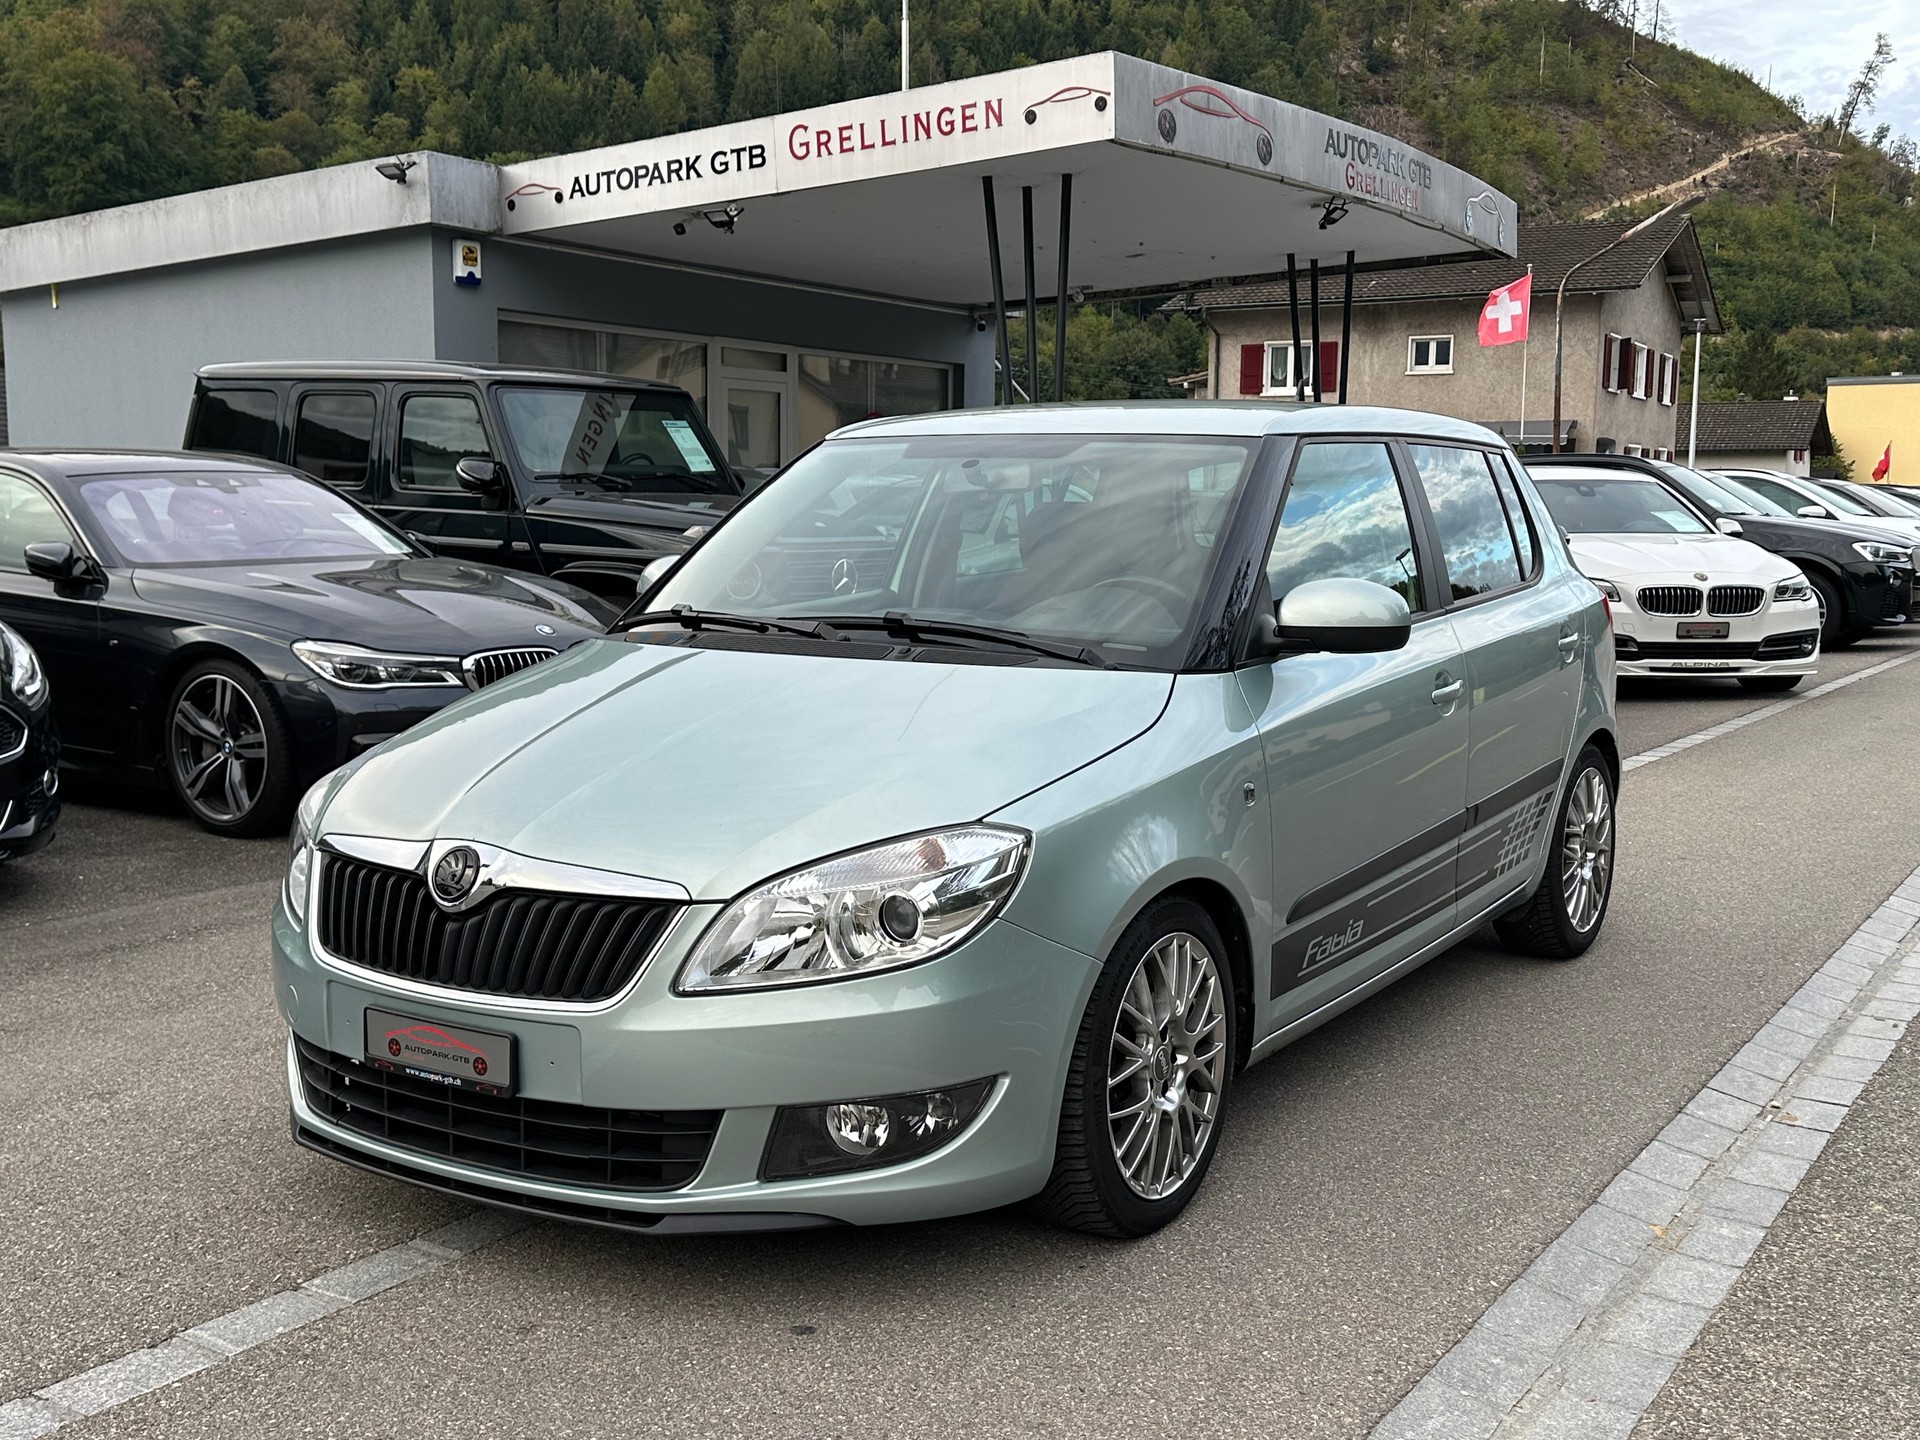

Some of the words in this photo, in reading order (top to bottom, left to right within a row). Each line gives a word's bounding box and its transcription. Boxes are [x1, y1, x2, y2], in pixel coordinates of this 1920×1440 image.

[568, 154, 704, 200] AUTOPARK
[710, 144, 767, 175] GTB
[788, 98, 1004, 161] GRELLINGEN
[1325, 128, 1405, 179] AUTOPARK
[1408, 158, 1432, 190] GTB
[1345, 162, 1418, 210] GRELLINGEN
[1301, 918, 1364, 969] Fabia
[404, 1043, 470, 1064] AUTOPARK-GTB
[405, 1068, 462, 1086] www.autopark-gtb.ch
